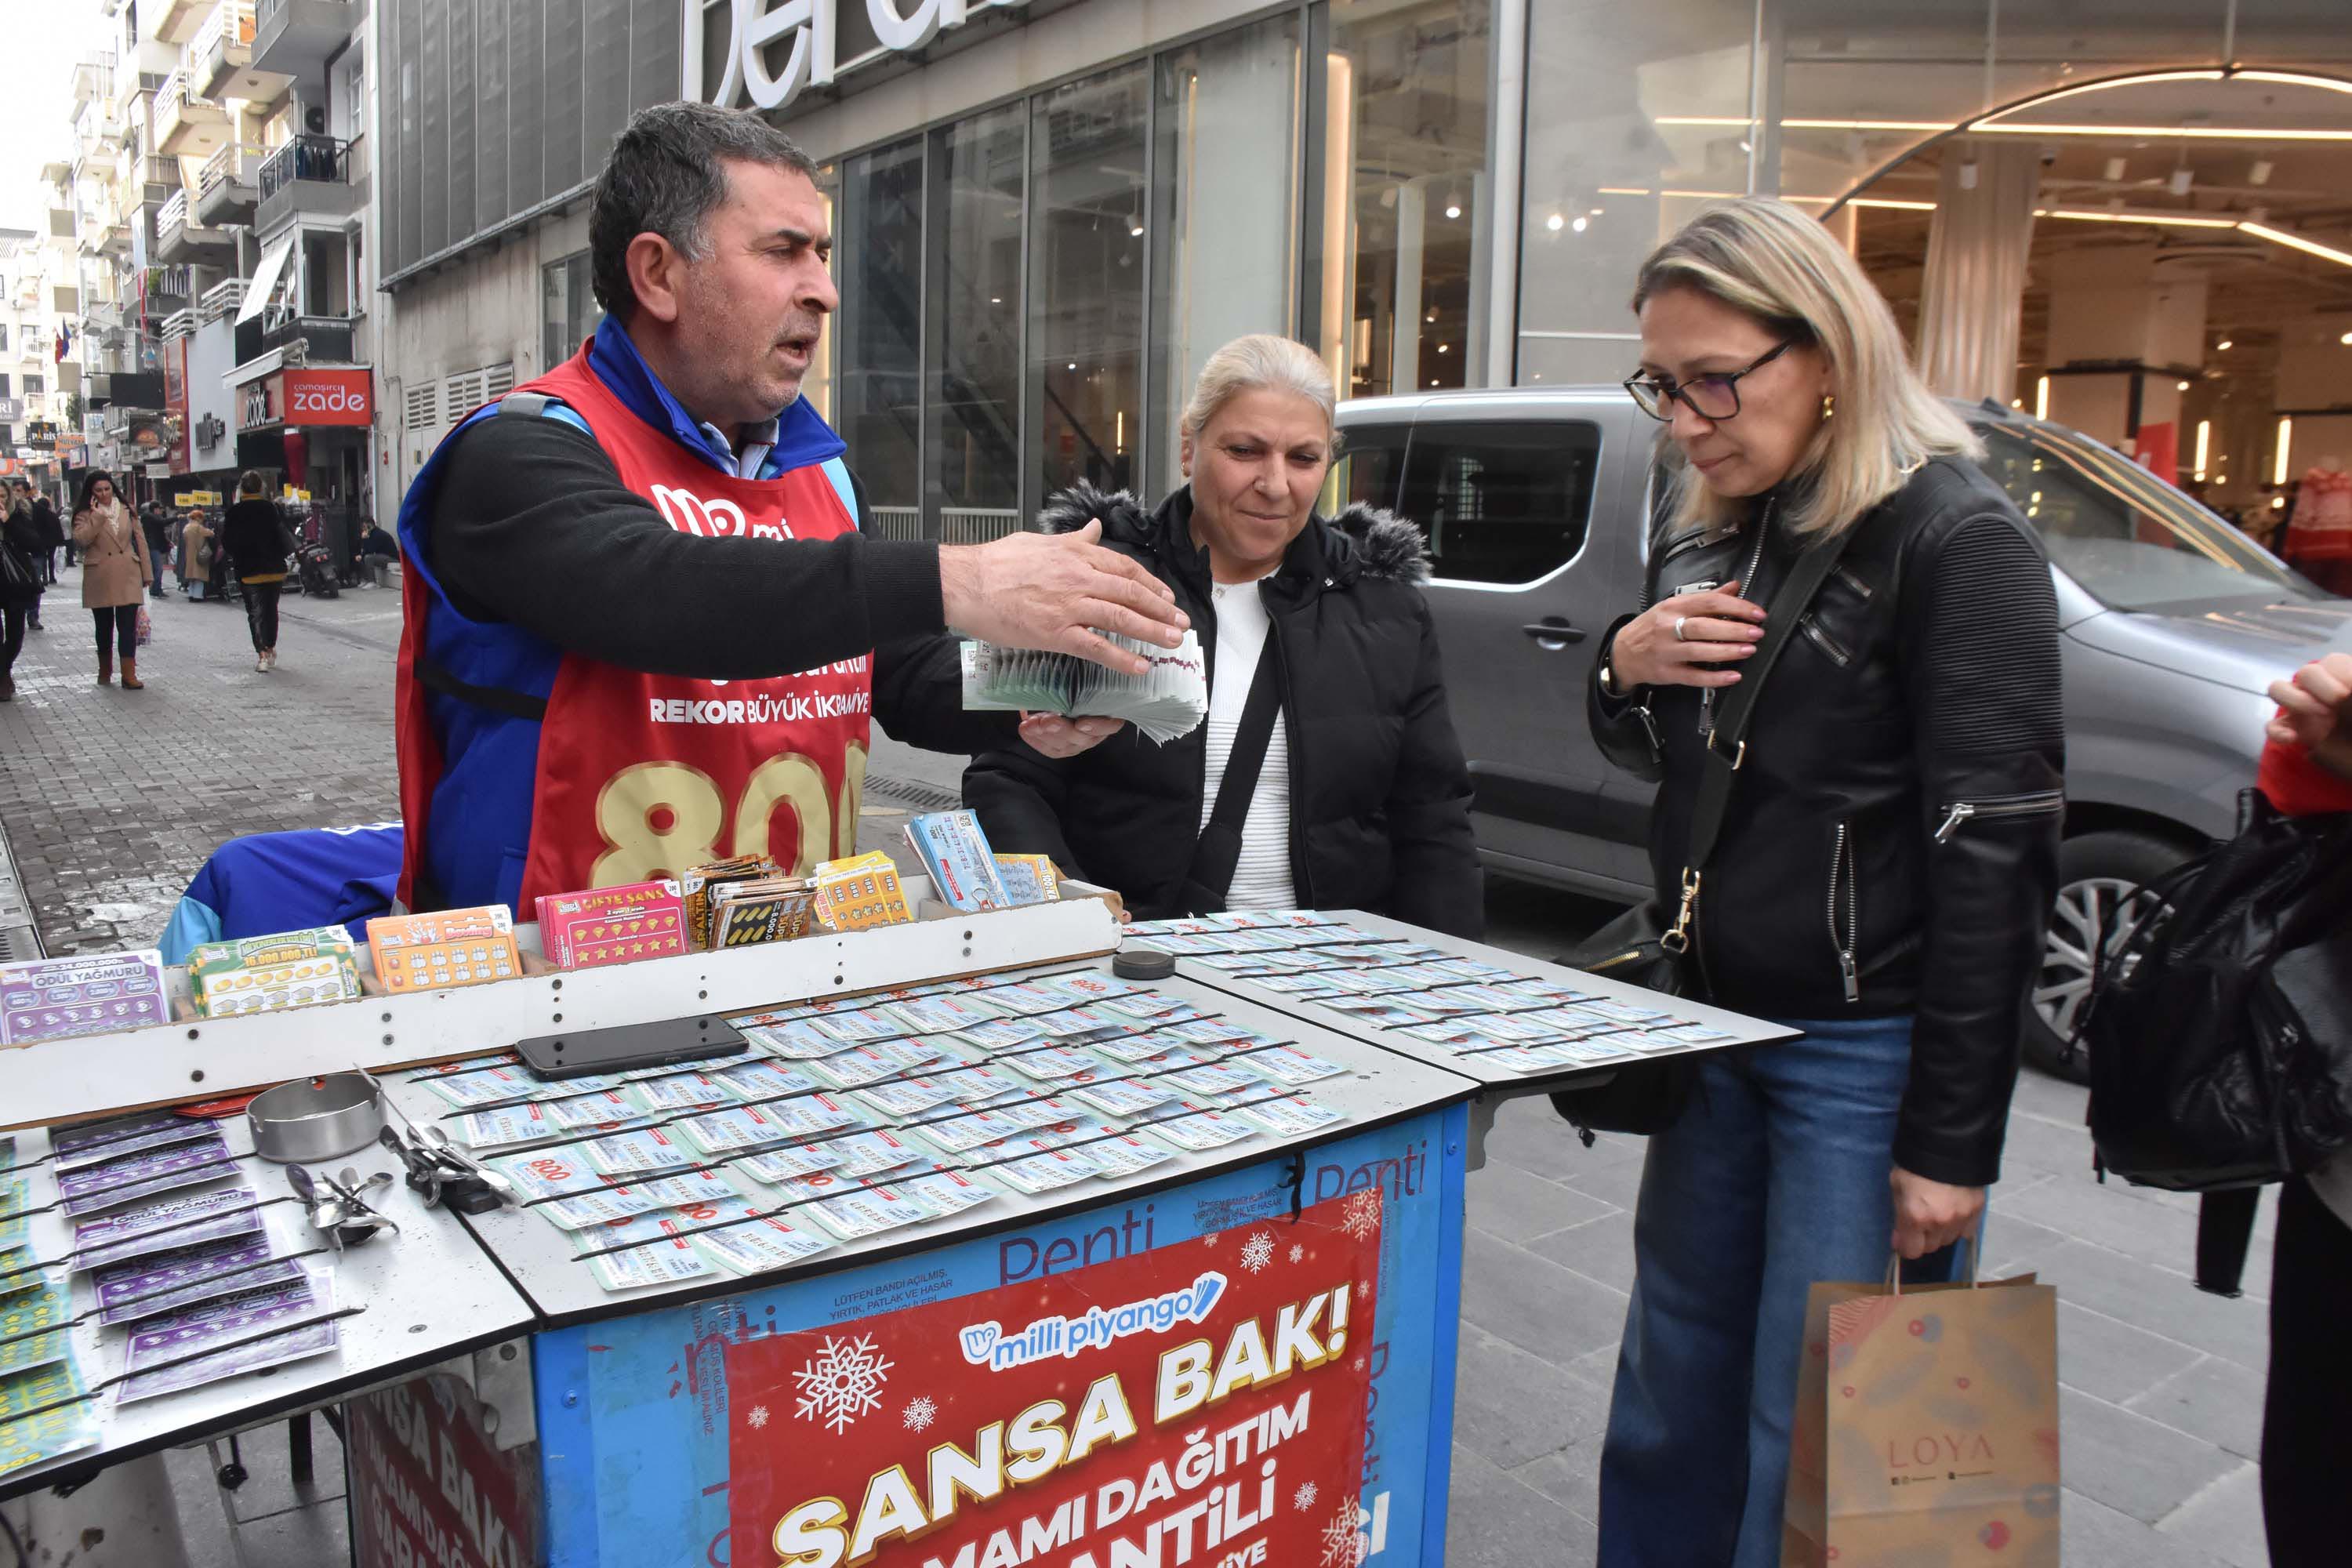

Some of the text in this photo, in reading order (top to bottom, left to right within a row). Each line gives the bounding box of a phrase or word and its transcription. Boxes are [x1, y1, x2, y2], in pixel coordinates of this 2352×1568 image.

[294, 385, 365, 412] zade
[650, 687, 869, 724] REKOR BÜYÜK İKRAMİYE
[834, 886, 845, 902] 1000
[849, 881, 860, 898] 1000
[864, 877, 874, 894] 1000
[885, 875, 895, 891] 1000
[74, 964, 143, 982] YAĞMURU
[530, 1159, 572, 1181] 800
[866, 1293, 904, 1310] PATLAK
[904, 1289, 918, 1300] VE
[920, 1279, 953, 1295] HASAR
[875, 1279, 906, 1296] BANDI
[994, 1292, 1193, 1367] milli piyango
[1154, 1281, 1350, 1427] BAK!
[1096, 1390, 1310, 1532] DAĞITIM
[1888, 1433, 1994, 1468] LOYA
